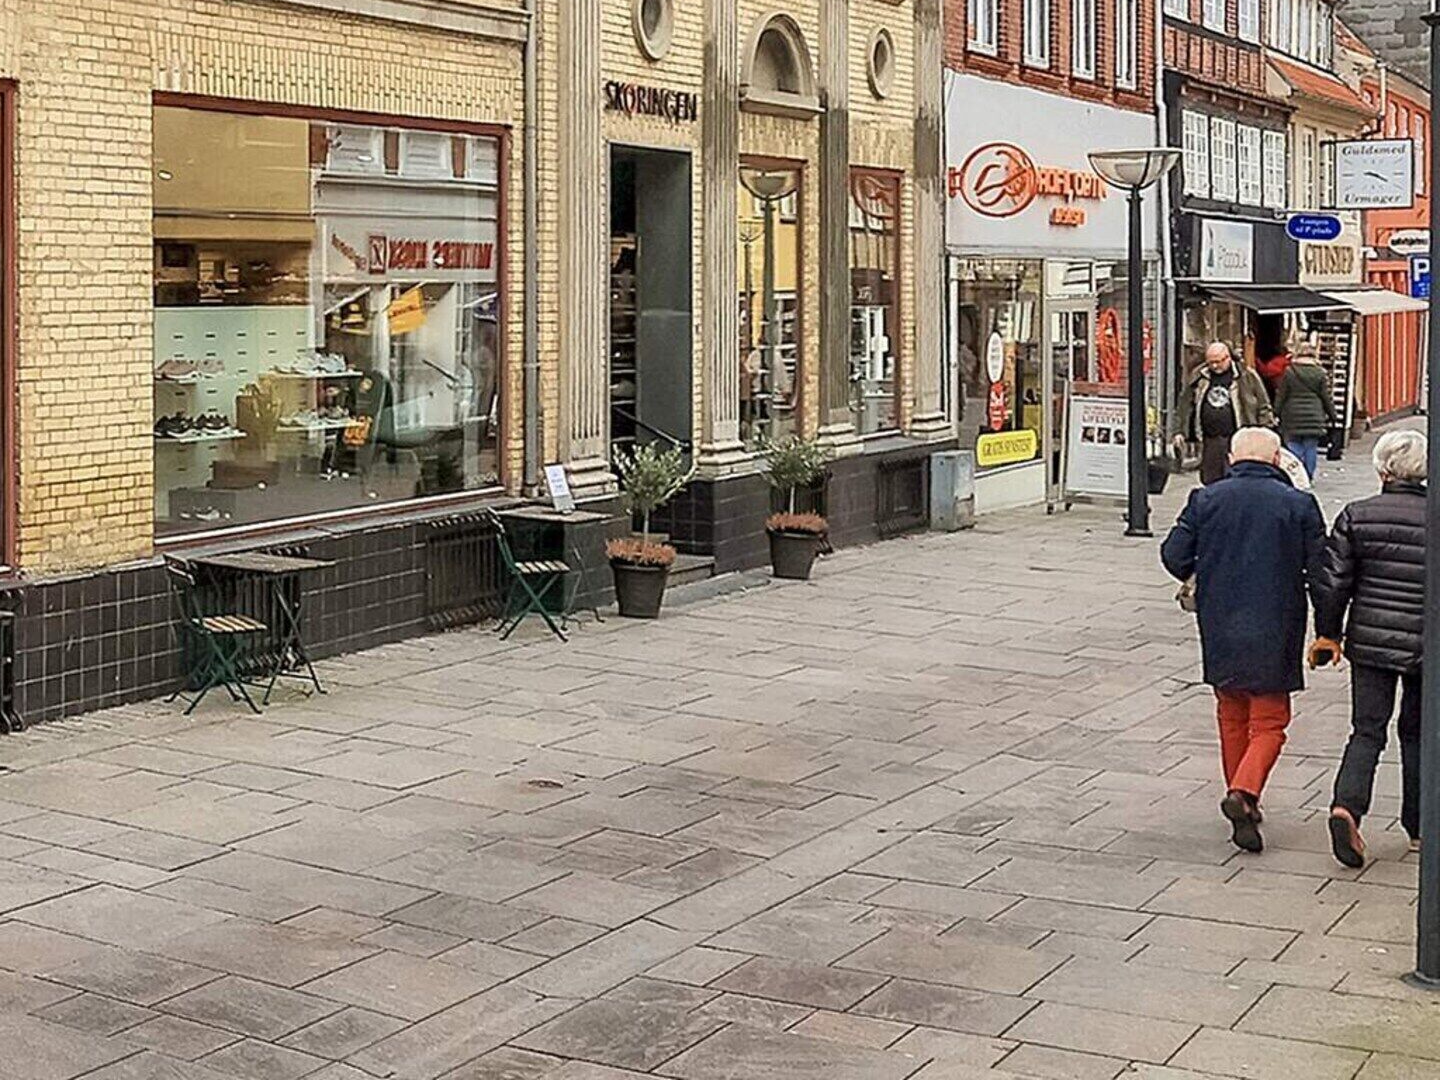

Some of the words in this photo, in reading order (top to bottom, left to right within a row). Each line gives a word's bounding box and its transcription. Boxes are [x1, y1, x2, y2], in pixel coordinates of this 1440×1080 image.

[1342, 144, 1406, 156] Guldsmed
[1344, 193, 1401, 204] Urmager
[1414, 258, 1430, 282] P
